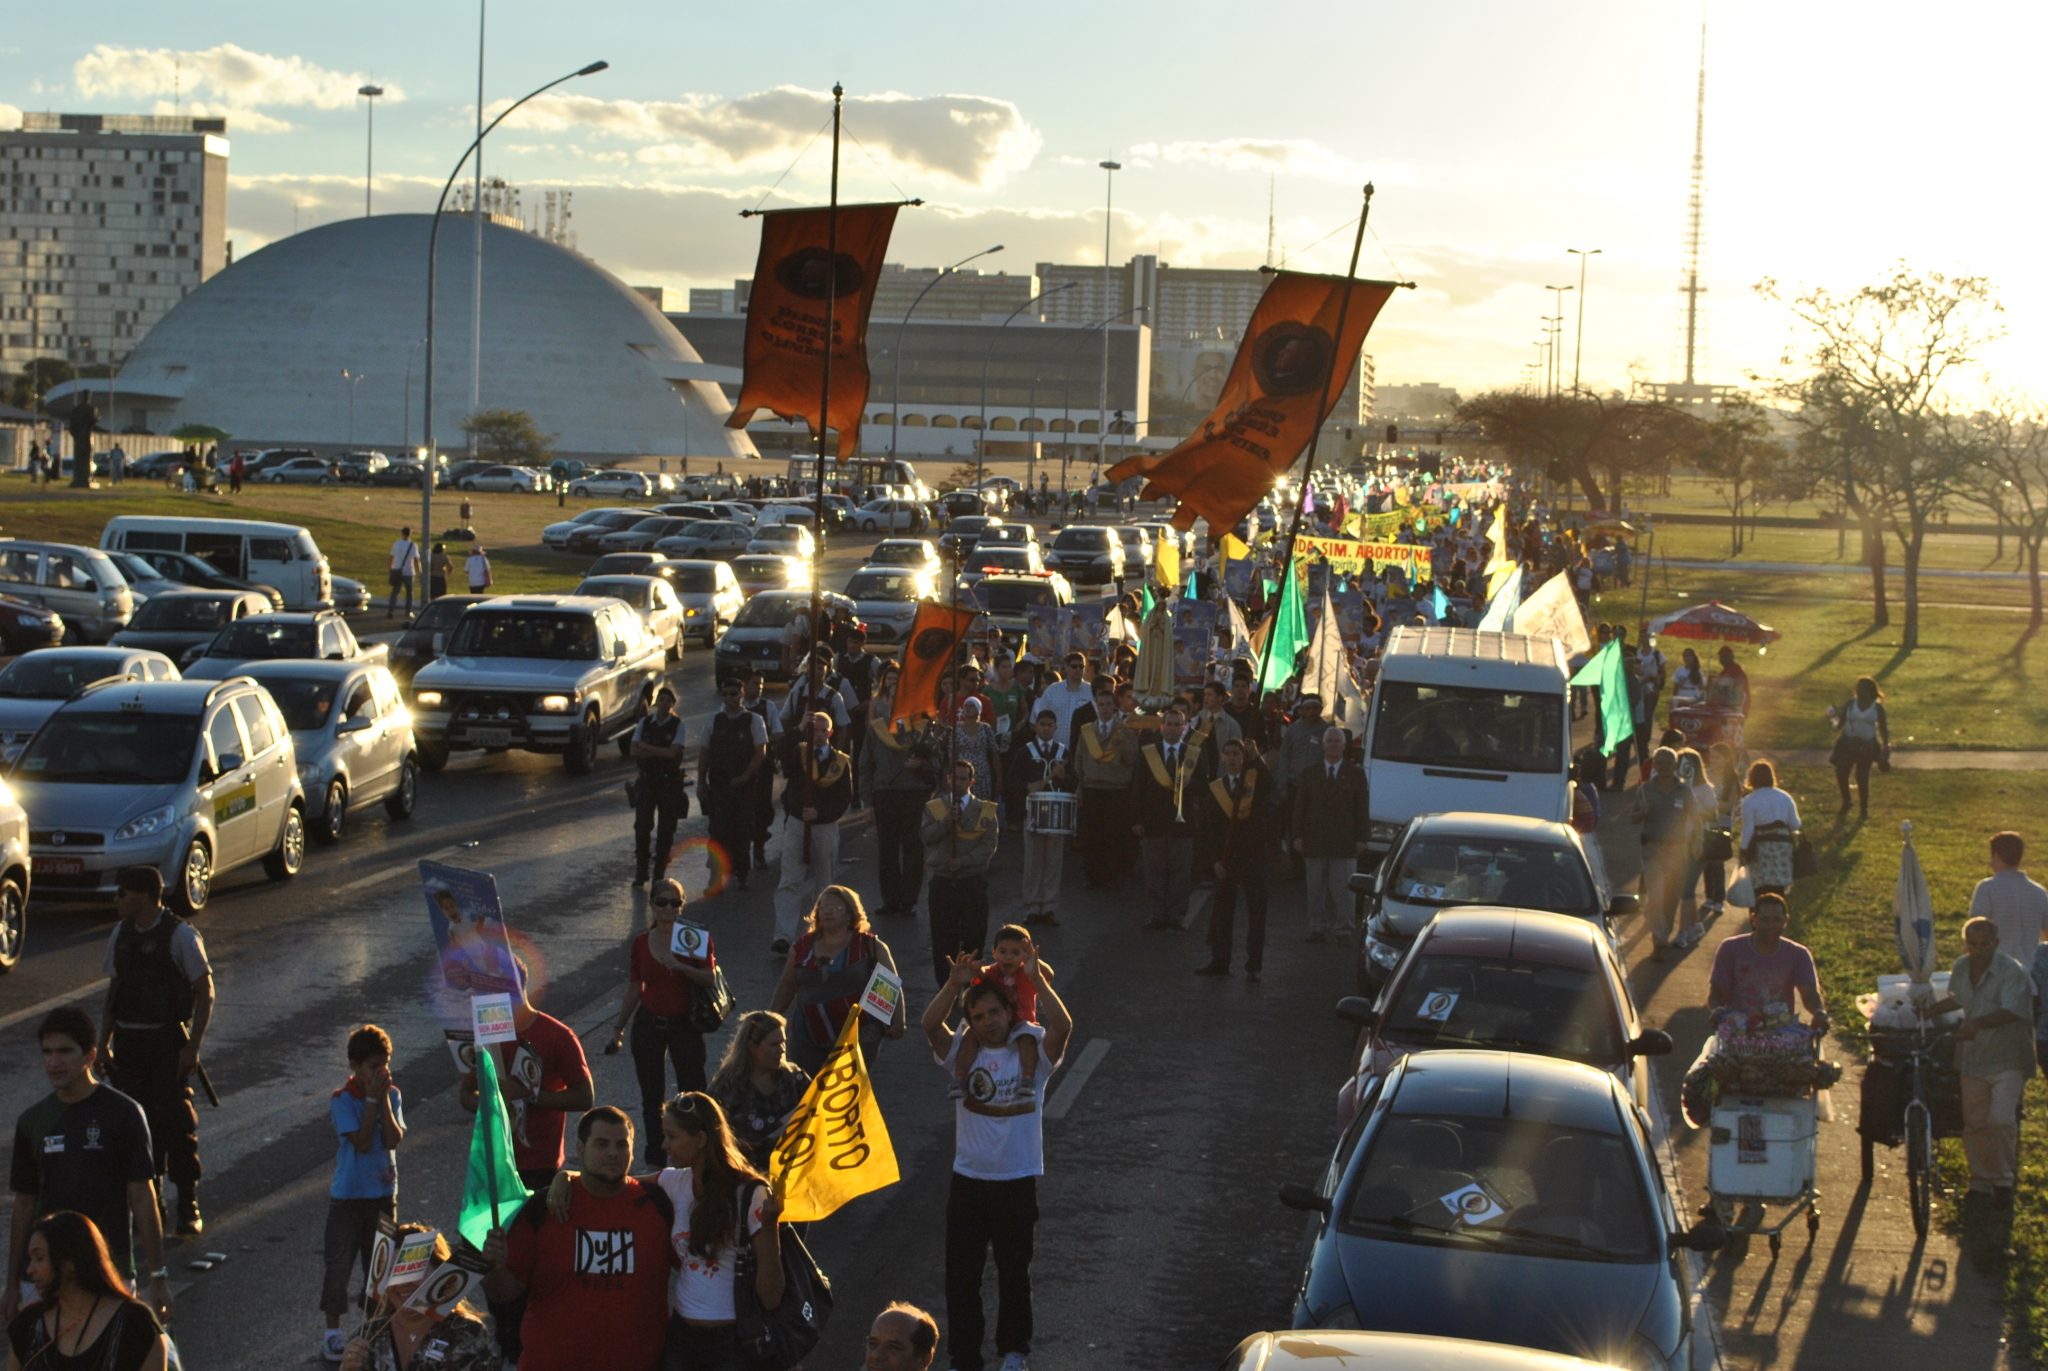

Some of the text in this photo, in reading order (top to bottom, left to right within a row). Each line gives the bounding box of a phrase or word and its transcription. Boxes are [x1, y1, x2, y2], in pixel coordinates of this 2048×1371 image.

[1295, 539, 1314, 553] IDA
[1320, 542, 1352, 558] SIM.
[1355, 545, 1410, 561] ABORTO
[776, 1103, 819, 1170] ÃO
[816, 1043, 870, 1171] ABORTO
